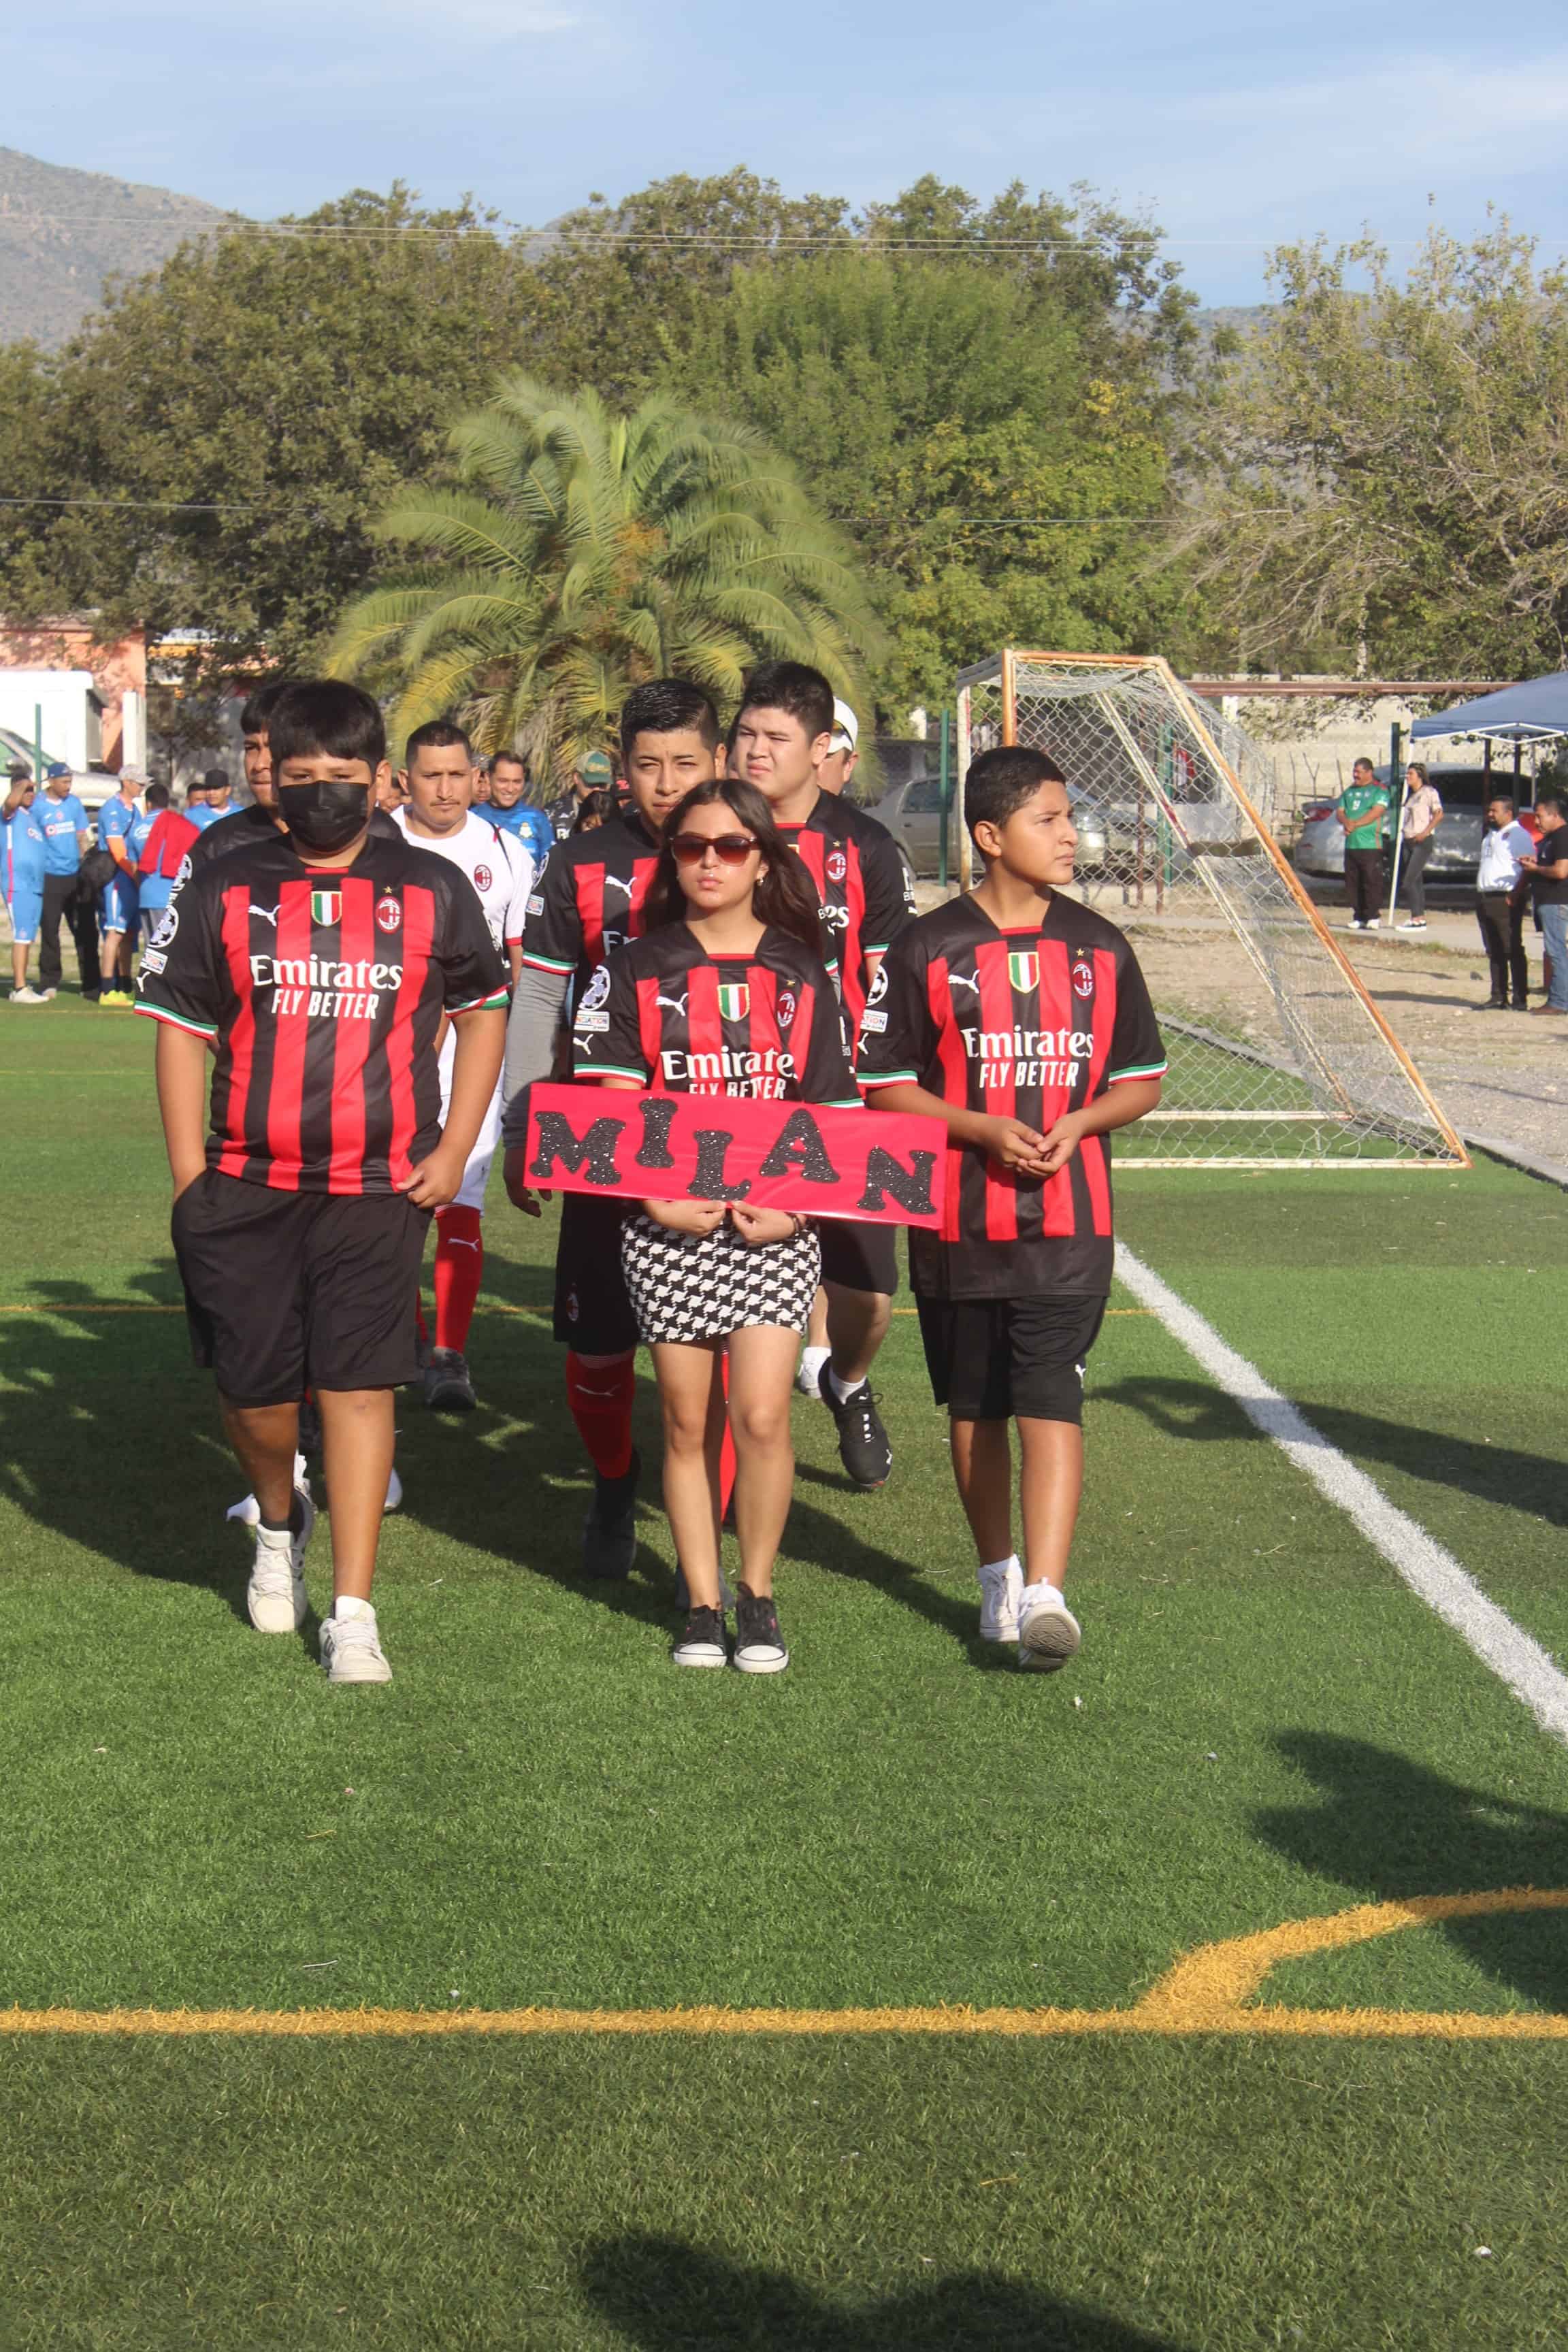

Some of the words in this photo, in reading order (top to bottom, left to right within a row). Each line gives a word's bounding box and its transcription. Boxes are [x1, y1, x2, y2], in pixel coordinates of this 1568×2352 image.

[249, 953, 403, 990] Emirates
[272, 988, 304, 1015] FLY
[307, 991, 379, 1019] BETTER
[960, 1024, 1094, 1058] Emirates
[660, 1045, 798, 1079] Emirate
[979, 1062, 1010, 1088] FLY
[1015, 1061, 1079, 1087] BETTER
[529, 1097, 937, 1215] MILAN
